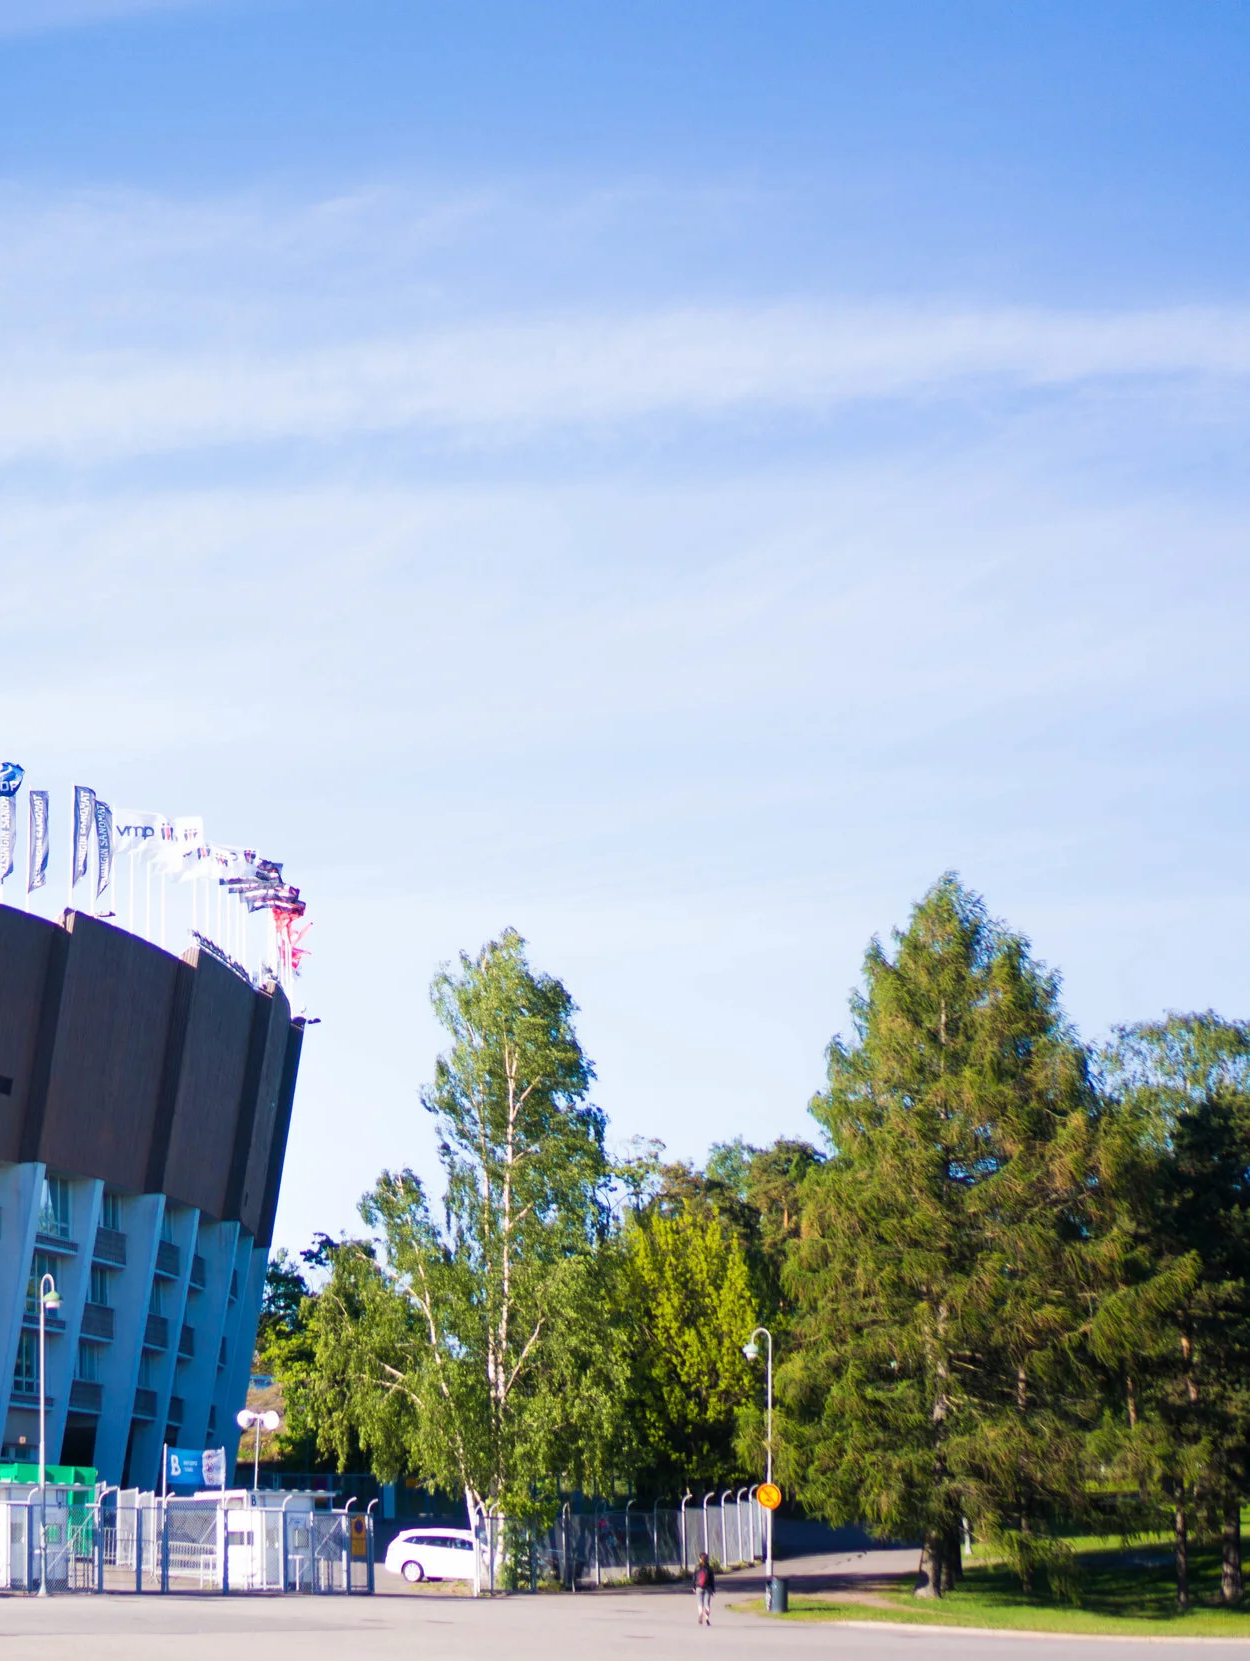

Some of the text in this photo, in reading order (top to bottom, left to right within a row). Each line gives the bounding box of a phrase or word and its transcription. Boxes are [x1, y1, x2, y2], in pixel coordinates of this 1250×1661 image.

[33, 794, 43, 838] SANOMAT
[97, 804, 108, 847] SANOMAT
[171, 1454, 181, 1477] B
[251, 1494, 257, 1507] B
